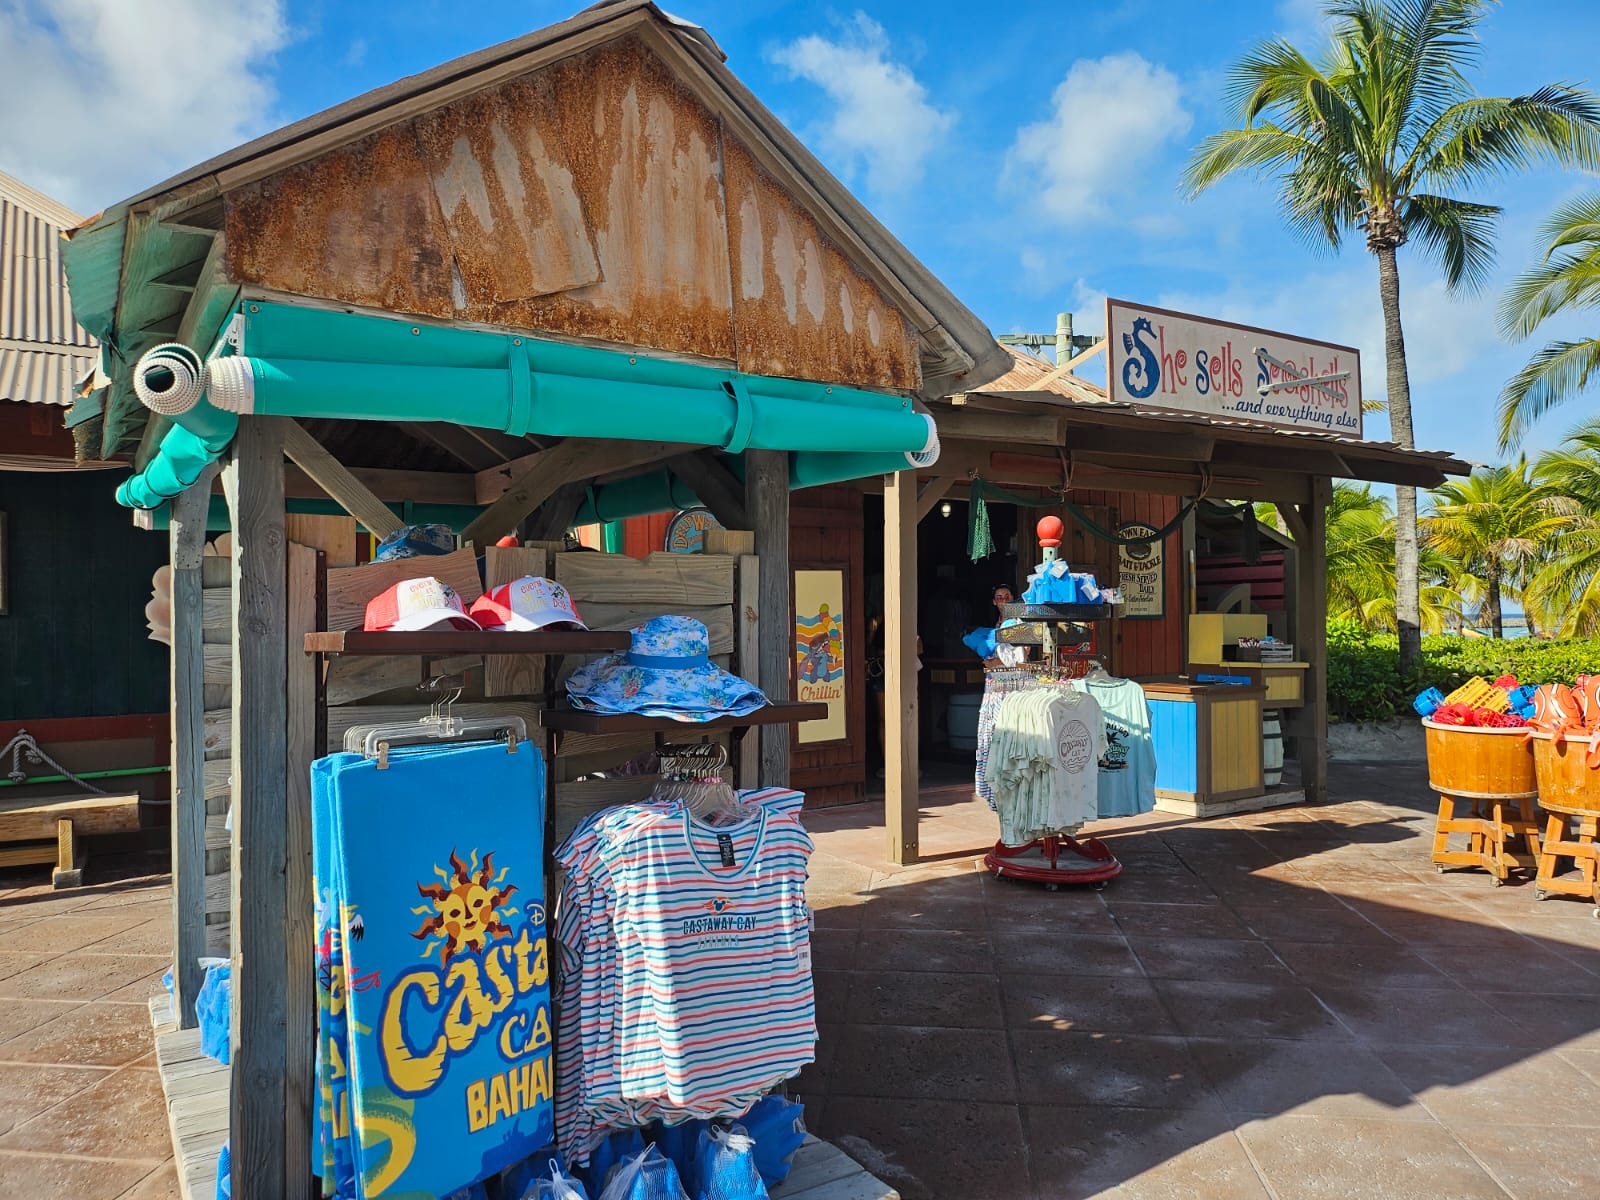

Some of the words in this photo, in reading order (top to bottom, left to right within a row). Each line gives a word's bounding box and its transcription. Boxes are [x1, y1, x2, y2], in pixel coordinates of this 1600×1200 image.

[1122, 316, 1187, 399] She
[1266, 403, 1333, 428] everything
[1336, 410, 1359, 428] else
[1119, 573, 1135, 582] RESH
[800, 685, 843, 701] Chillin'
[683, 917, 733, 935] CASTAWAY
[737, 916, 757, 930] CAY
[466, 1053, 553, 1134] BAHA
